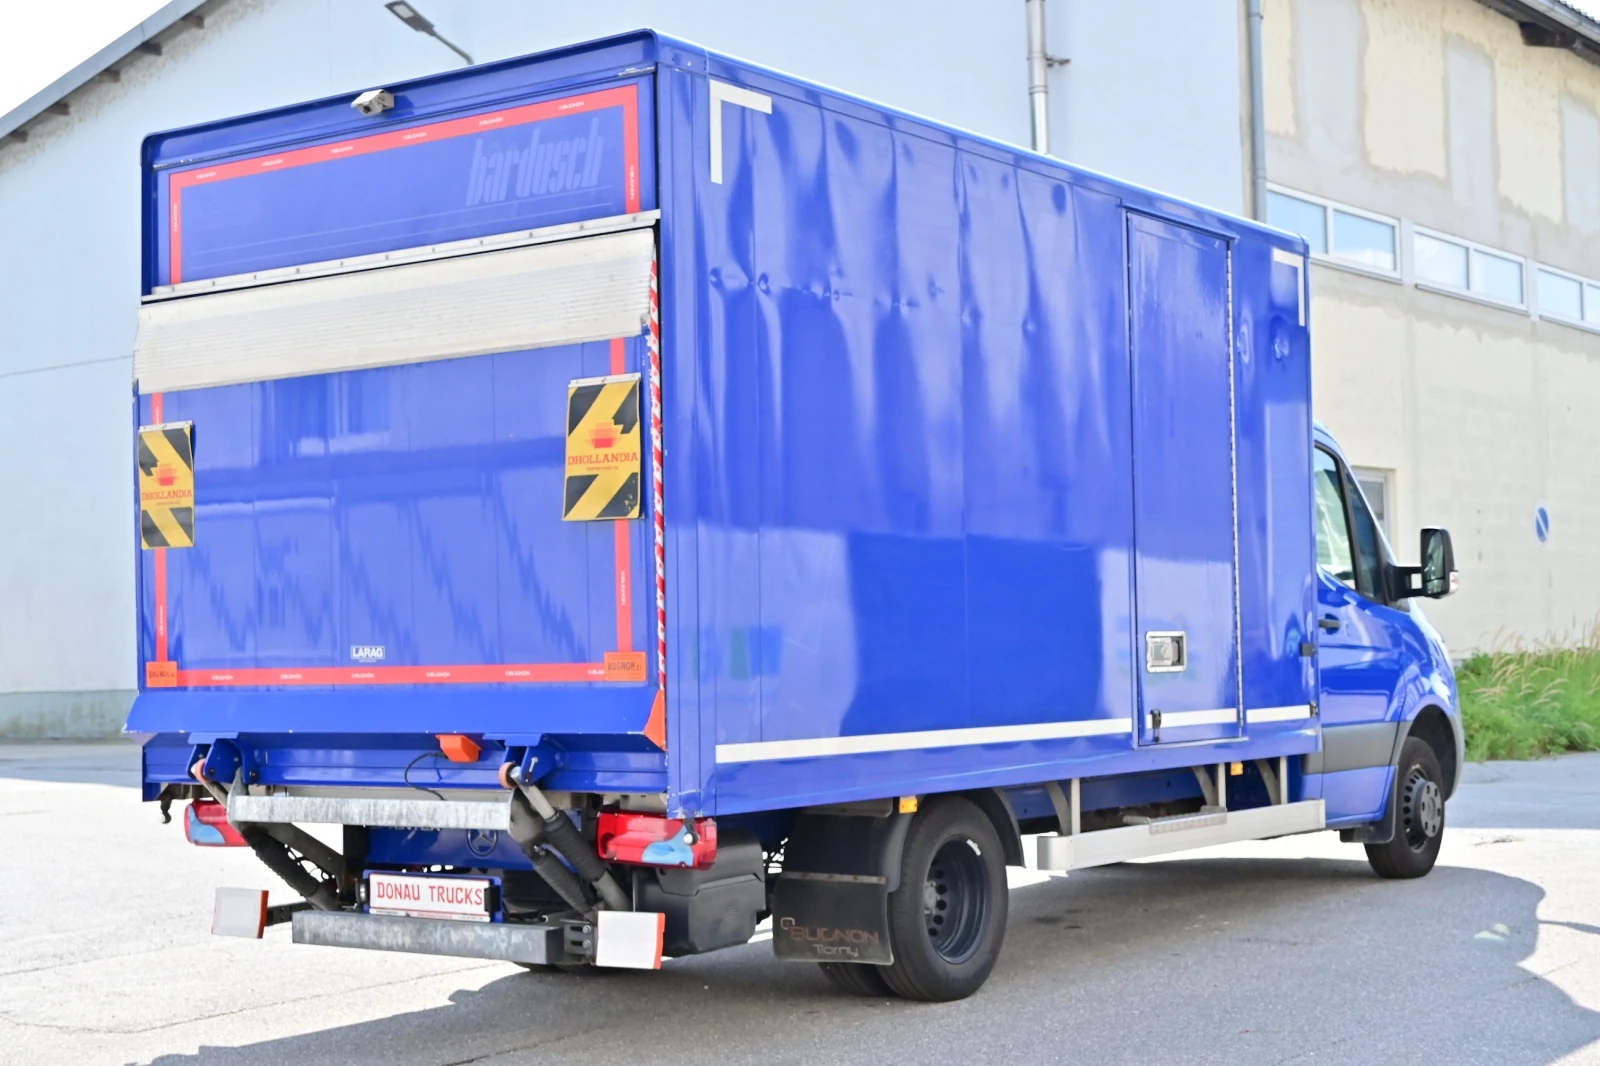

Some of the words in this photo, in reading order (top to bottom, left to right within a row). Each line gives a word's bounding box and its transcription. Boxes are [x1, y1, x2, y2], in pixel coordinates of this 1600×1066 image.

[567, 452, 639, 466] DHOLLANDIA
[142, 489, 193, 501] DHOLLANDIA
[352, 647, 384, 659] LARAG
[376, 881, 421, 901] DONAU
[428, 885, 484, 906] TRUCKS
[790, 925, 880, 944] BUGNON
